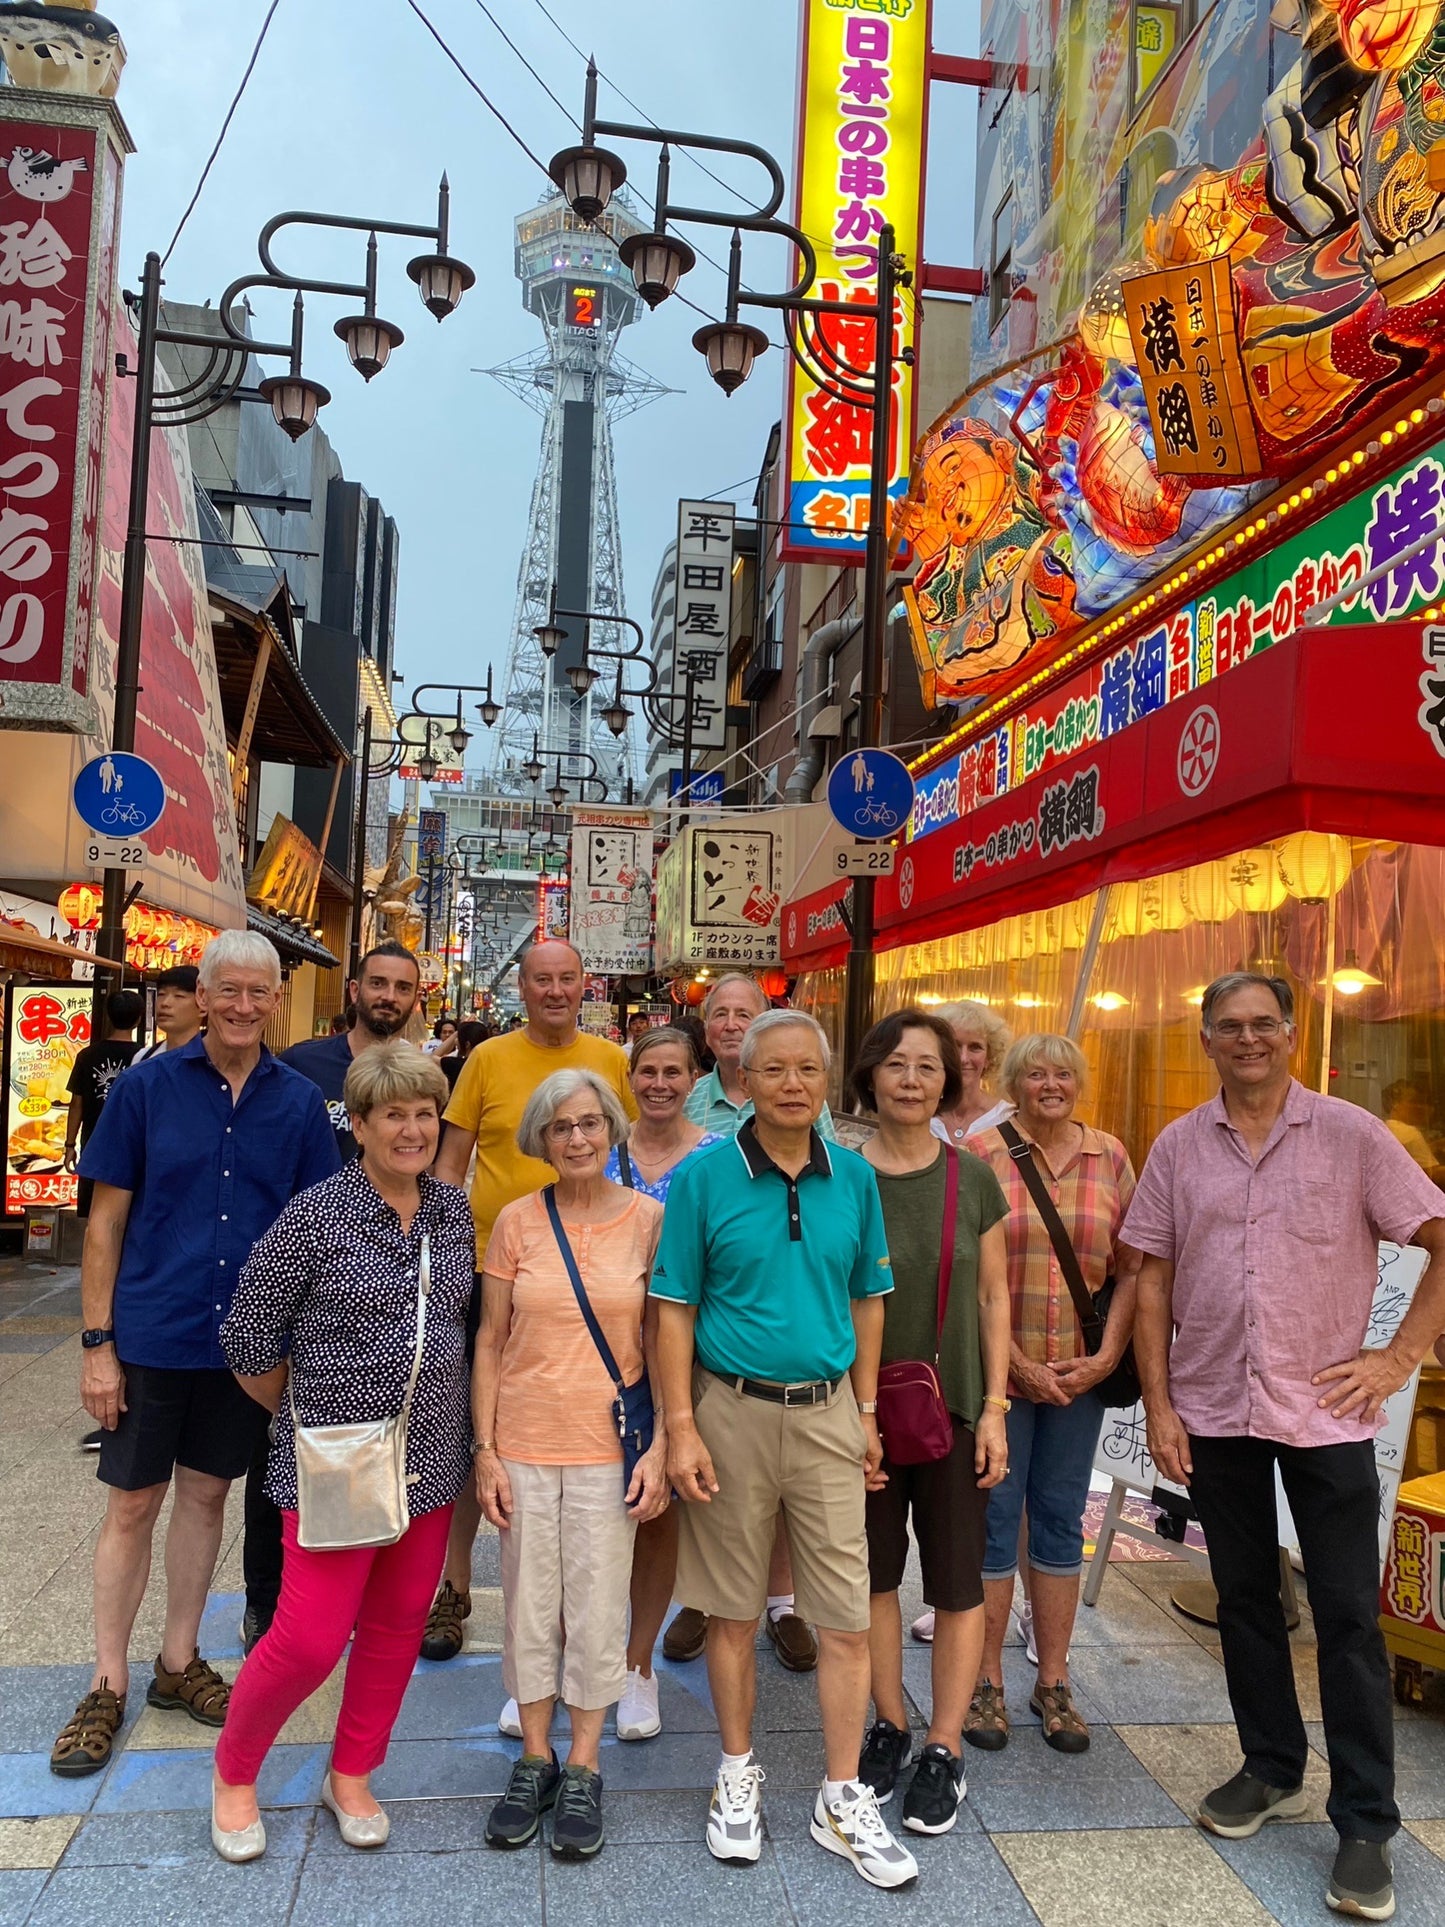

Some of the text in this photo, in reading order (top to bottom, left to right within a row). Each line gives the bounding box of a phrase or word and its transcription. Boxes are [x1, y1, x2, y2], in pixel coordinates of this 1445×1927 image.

[834, 16, 890, 276] 日本一の串かつ
[576, 297, 592, 322] 2
[806, 282, 901, 483] 横綱
[1140, 295, 1199, 457] 横綱
[1185, 277, 1228, 469] 日本一の串かつ
[676, 511, 731, 731] 平田屋酒店
[1216, 549, 1363, 676] 日本一の串かつ
[1026, 699, 1098, 772] 日本一の串かつ
[1099, 628, 1167, 741] 横綱
[1170, 617, 1190, 700] 名門
[577, 813, 650, 827] 元祖串カツ専門店
[913, 781, 957, 831] 日本一の串かつ
[957, 734, 997, 818] 横綱
[996, 731, 1010, 794] 名門
[953, 768, 1098, 878] 日本一の串かつ 横綱
[745, 843, 760, 884] 新世界
[690, 946, 778, 960] 2F 座敷あります
[691, 932, 778, 946] 1F カウンター席
[1394, 1518, 1424, 1617] 新世界
